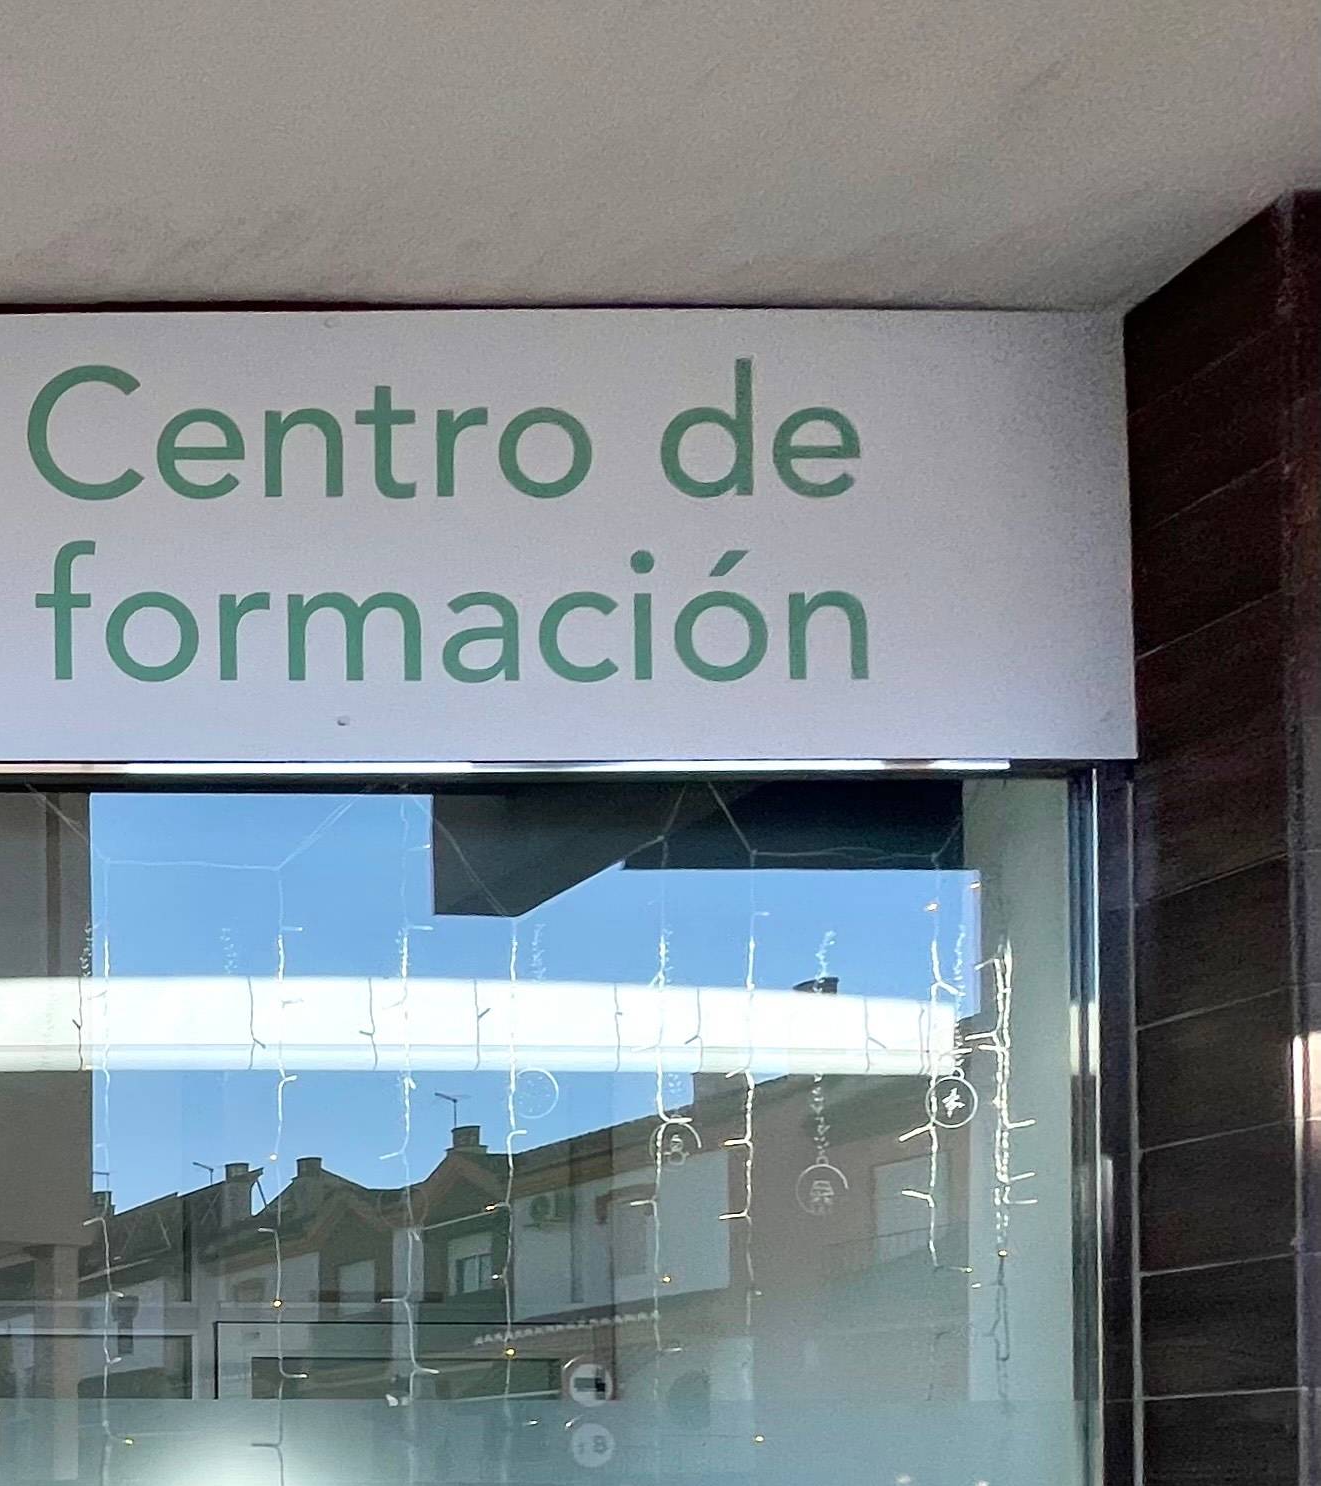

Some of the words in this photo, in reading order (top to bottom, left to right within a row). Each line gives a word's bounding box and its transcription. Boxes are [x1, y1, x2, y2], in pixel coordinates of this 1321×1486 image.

[26, 364, 593, 501] Centro
[659, 357, 862, 498] de
[34, 539, 871, 683] formación
